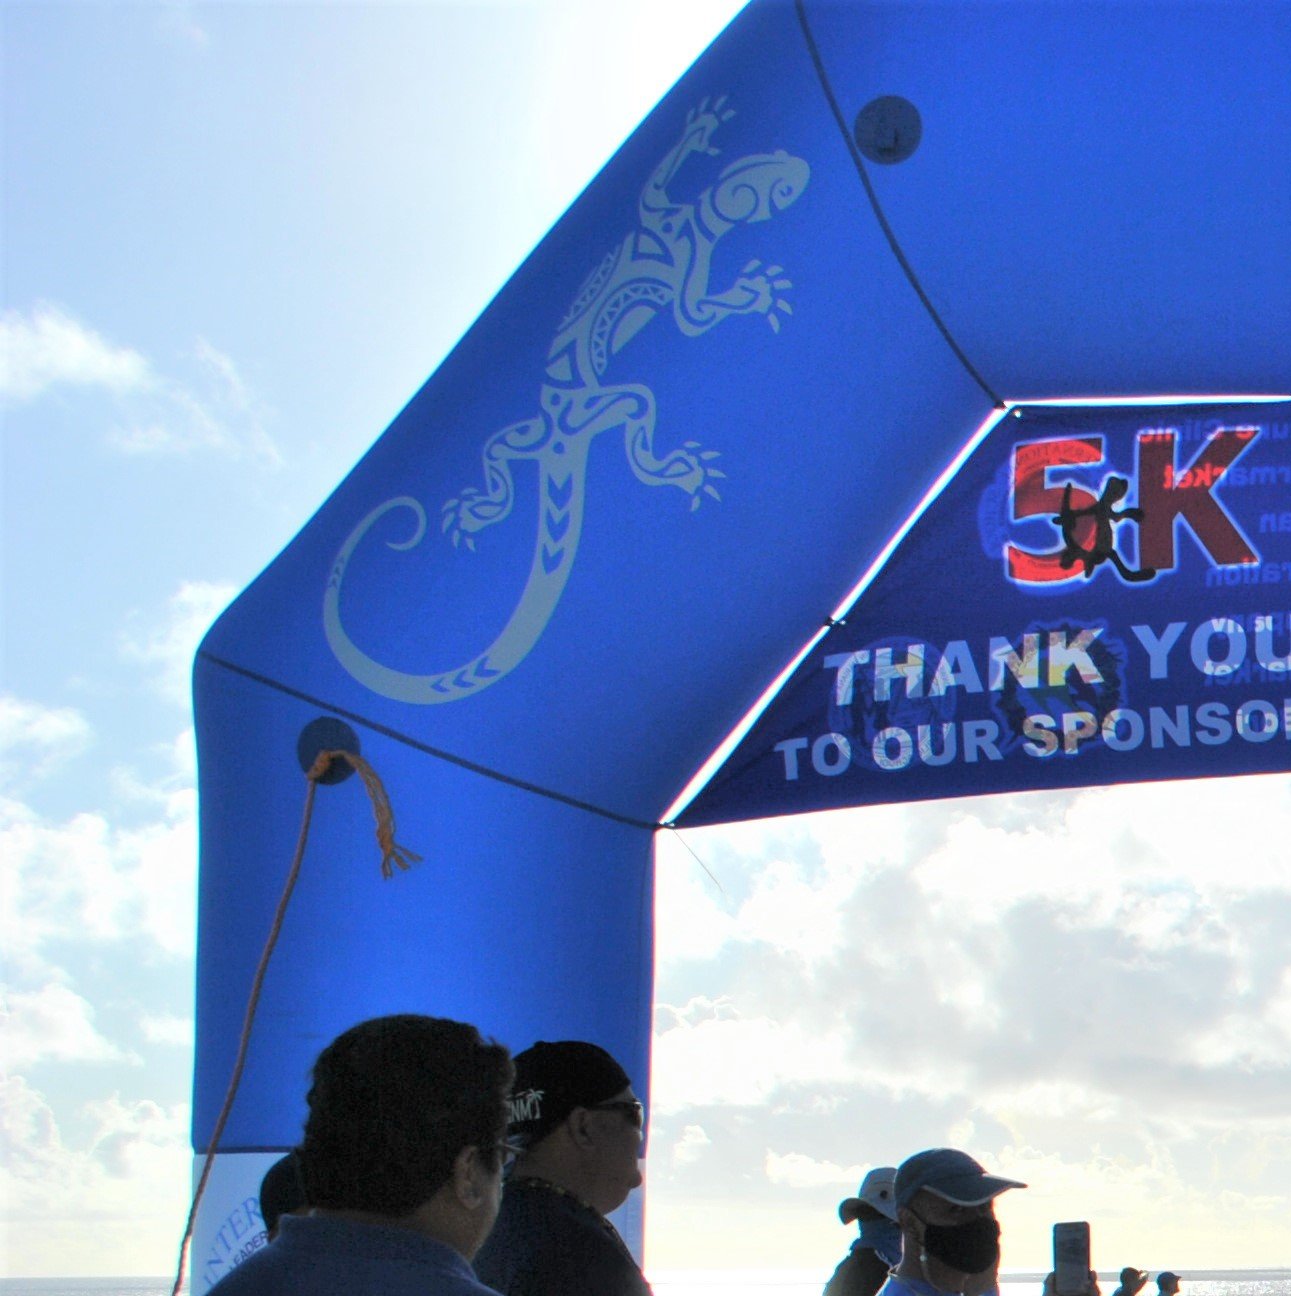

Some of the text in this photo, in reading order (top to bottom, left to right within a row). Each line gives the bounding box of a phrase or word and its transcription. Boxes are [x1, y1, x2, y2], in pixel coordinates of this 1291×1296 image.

[823, 627, 1105, 708] THANK
[773, 731, 853, 781] TO
[872, 718, 1004, 770] OUR
